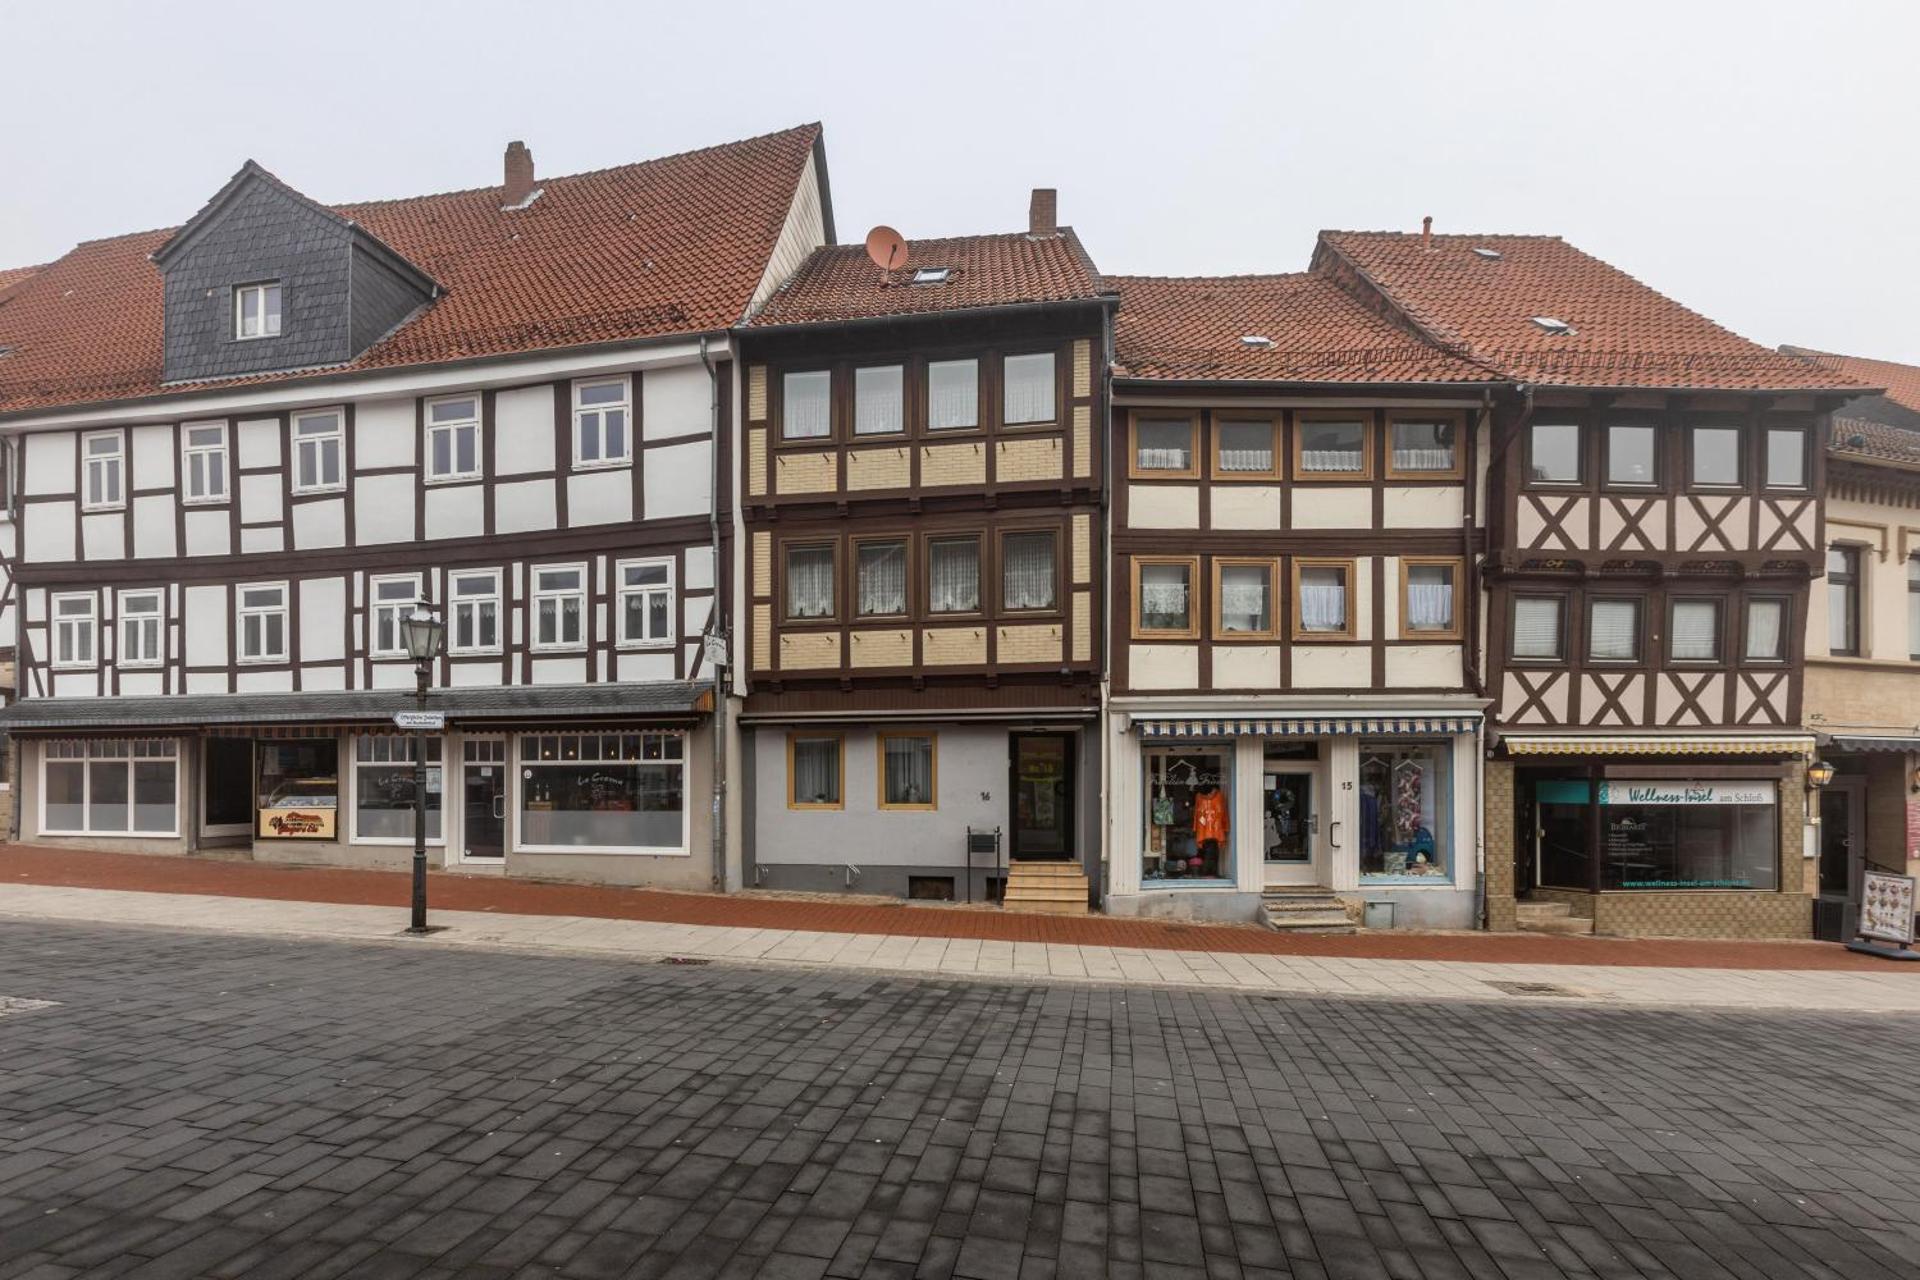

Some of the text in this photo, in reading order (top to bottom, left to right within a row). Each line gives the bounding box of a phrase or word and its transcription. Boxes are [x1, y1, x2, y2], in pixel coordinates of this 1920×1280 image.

[1341, 781, 1353, 791] 15
[981, 791, 991, 801] 16
[1628, 787, 1714, 803] Wellness-Insel
